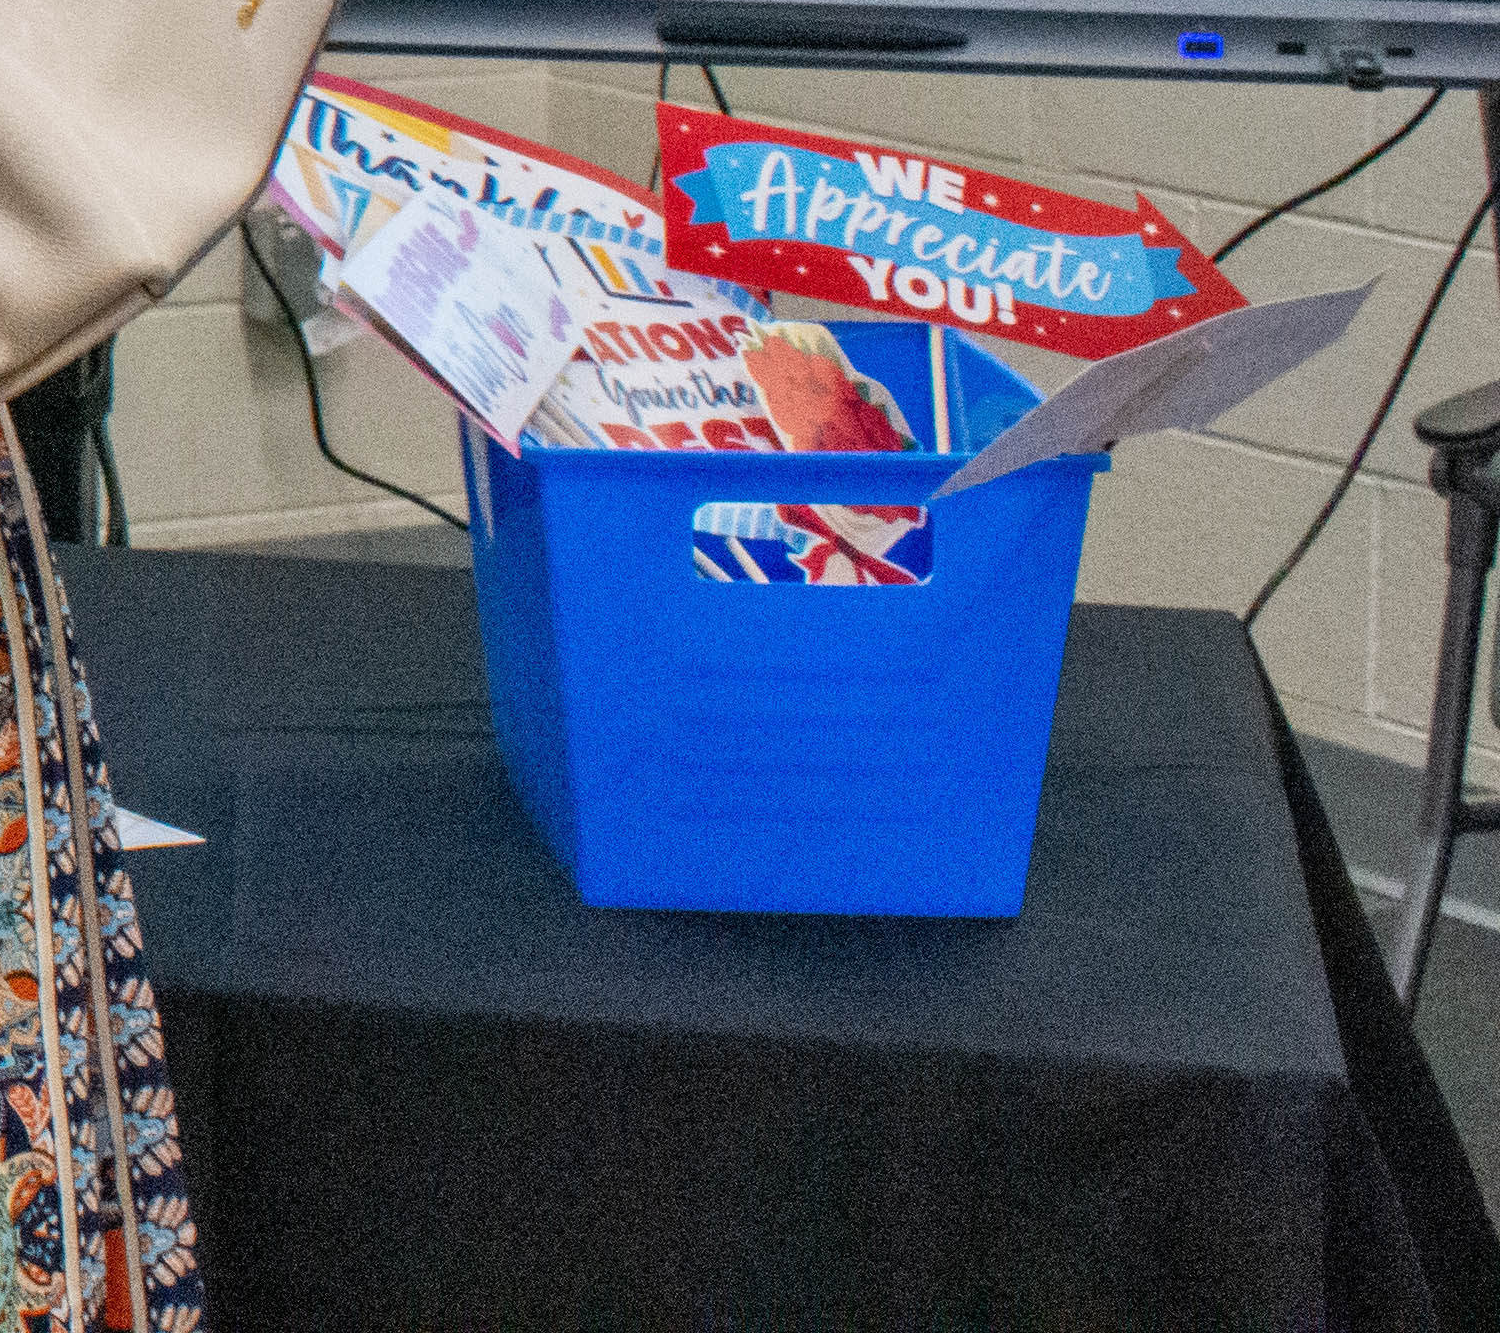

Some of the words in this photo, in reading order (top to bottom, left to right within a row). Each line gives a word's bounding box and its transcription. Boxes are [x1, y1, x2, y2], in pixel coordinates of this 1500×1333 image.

[853, 151, 966, 215] WE
[740, 149, 1115, 302] Appreciate
[847, 255, 1018, 326] YOU!
[584, 314, 751, 366] ATIONS
